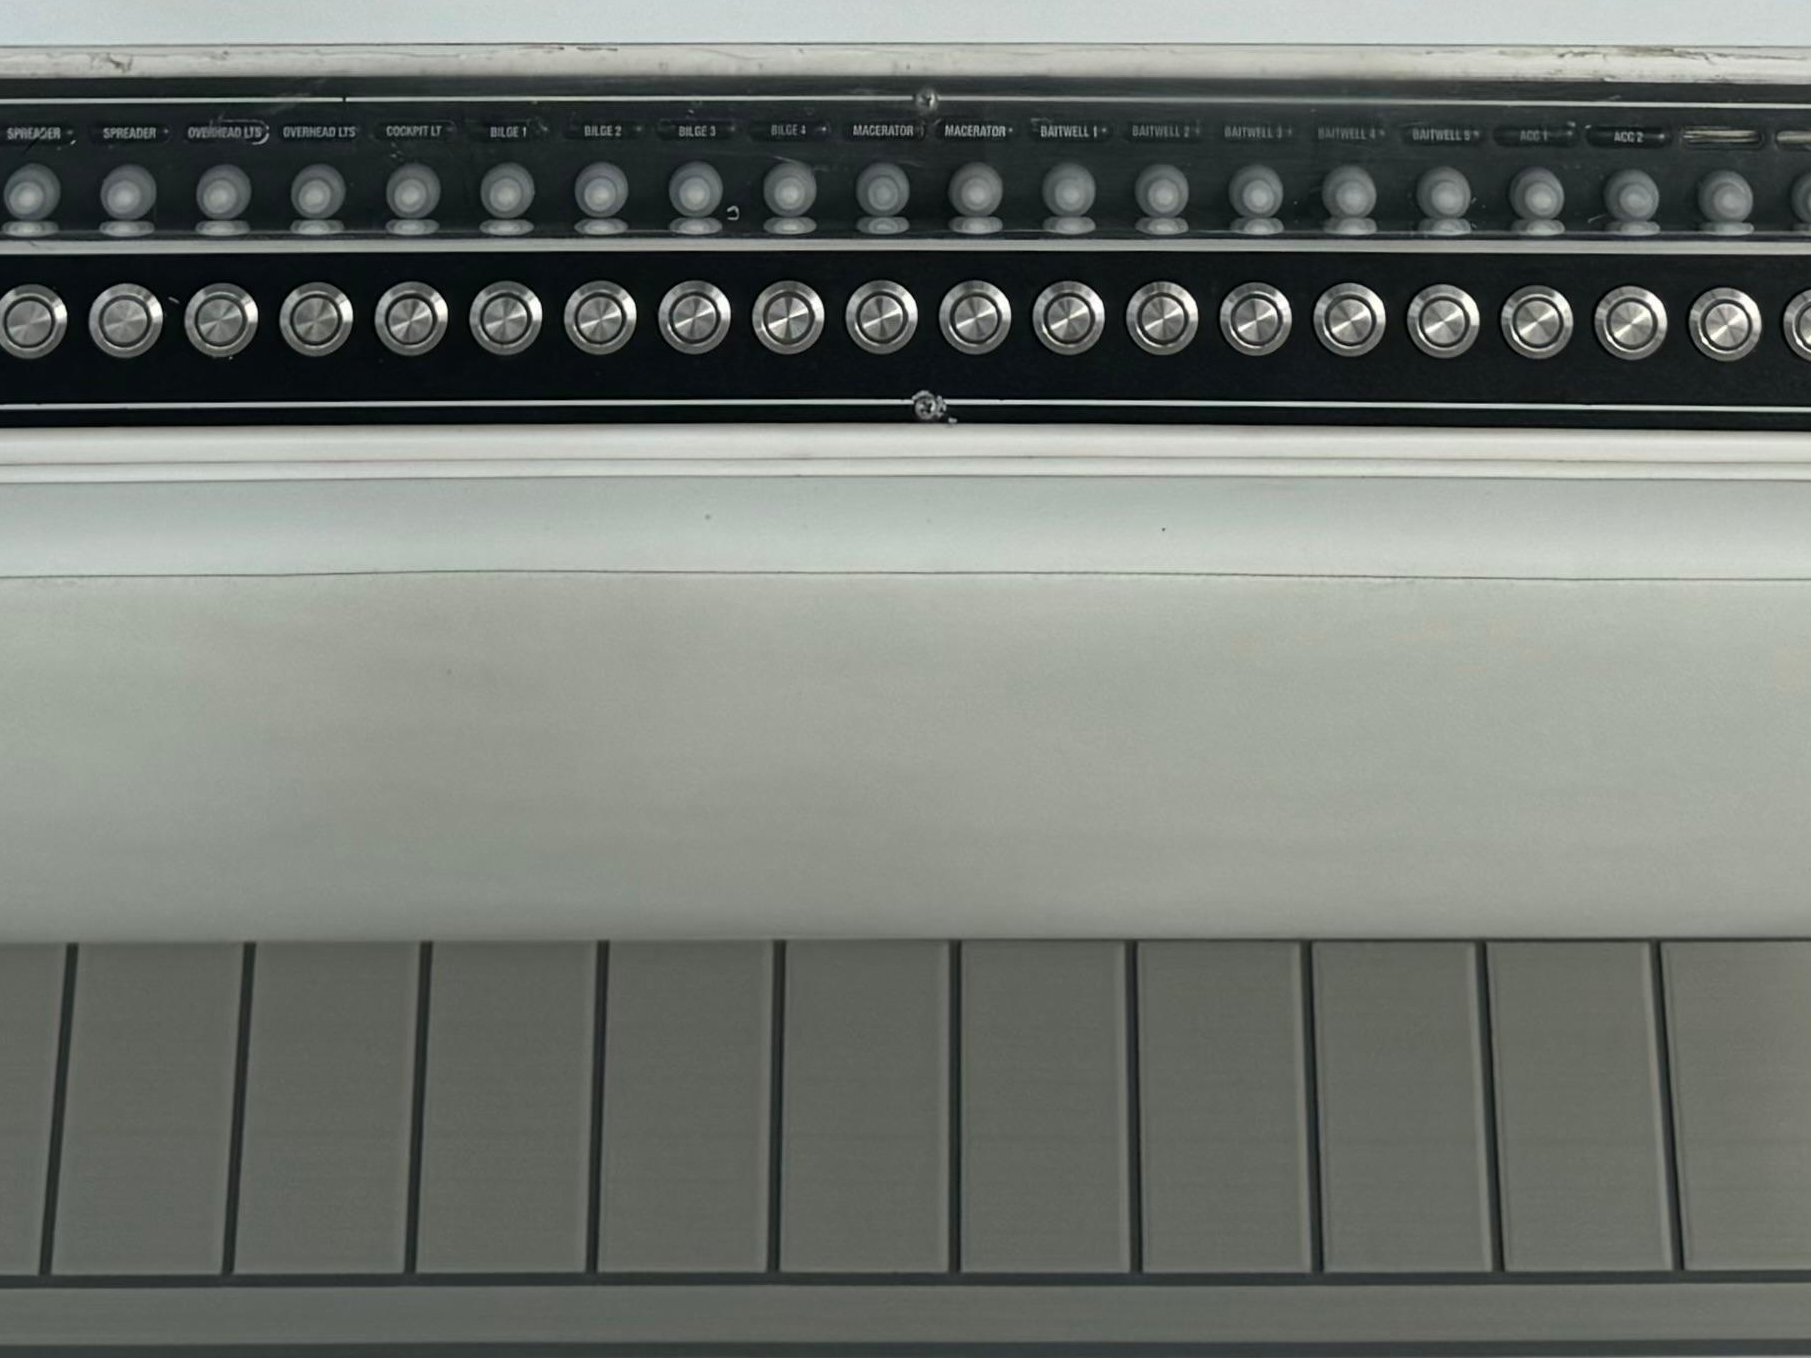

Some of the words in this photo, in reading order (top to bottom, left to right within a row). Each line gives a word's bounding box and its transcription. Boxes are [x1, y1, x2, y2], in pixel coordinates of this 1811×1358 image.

[6, 127, 61, 141] SPREADER
[102, 127, 157, 140] SPREADER
[282, 126, 336, 139] OVERHEAD
[338, 126, 357, 139] LTS
[386, 125, 429, 138] COCKPIT
[429, 125, 442, 137] LT
[490, 126, 519, 139] BILGE
[583, 125, 612, 138] BILGE
[678, 125, 707, 138] BILGE
[770, 124, 798, 136] BILGE
[852, 125, 914, 137] MACERATOR
[944, 125, 1007, 138] MACERATOR
[1039, 125, 1088, 138] BAITWELL
[1131, 124, 1180, 137] BAITWELL
[1224, 125, 1272, 139] BAITWELL
[1317, 126, 1367, 140] BAITWELL
[1412, 127, 1462, 141] BAITWELL
[1519, 128, 1541, 142] ACC
[1614, 129, 1635, 143] ACC
